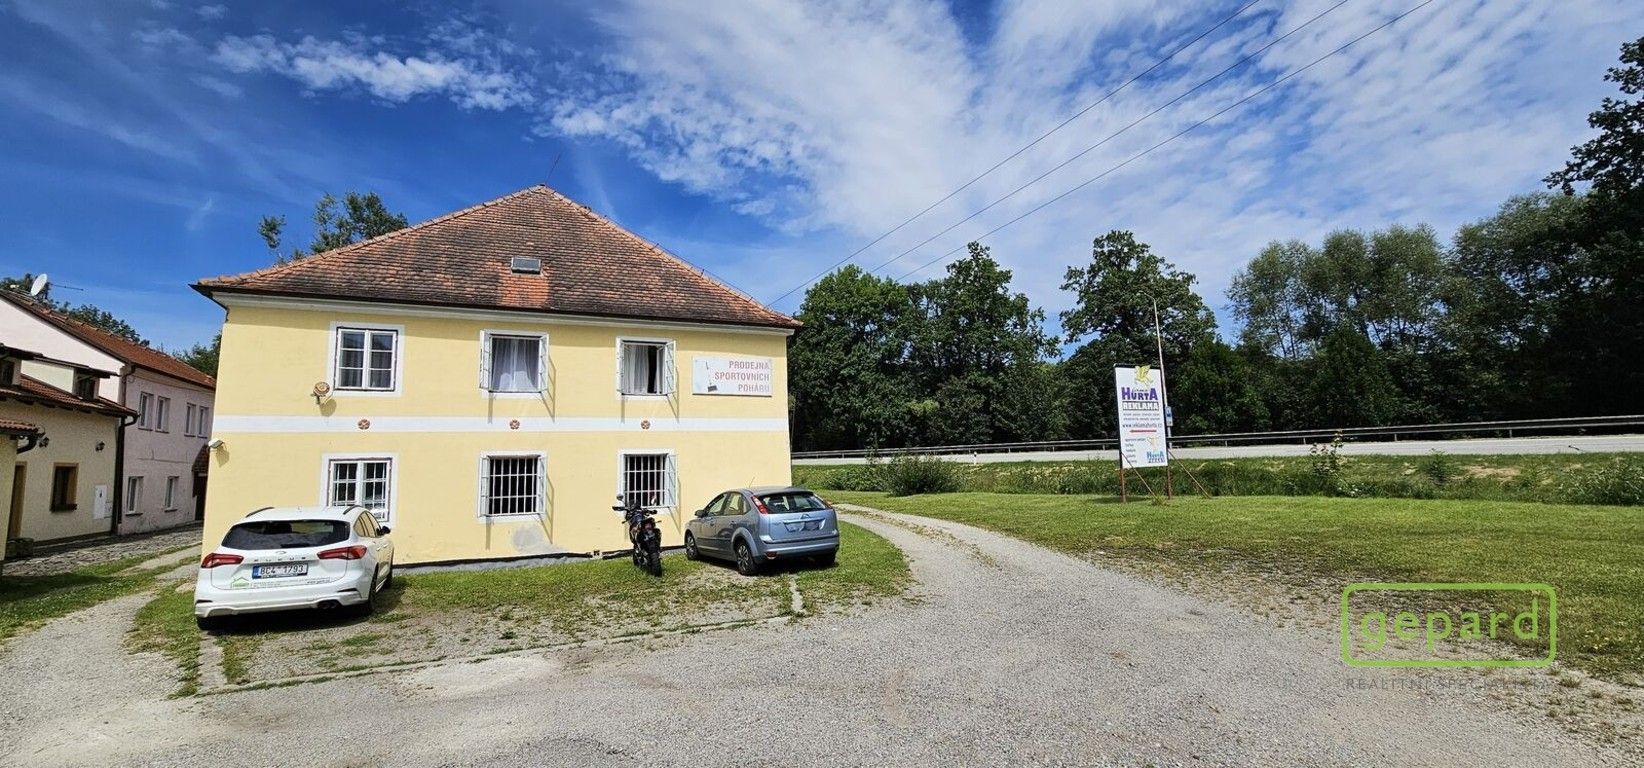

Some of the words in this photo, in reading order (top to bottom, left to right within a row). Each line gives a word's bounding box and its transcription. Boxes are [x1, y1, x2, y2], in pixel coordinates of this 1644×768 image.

[728, 360, 770, 370] PRODEJNA
[1121, 387, 1158, 401] HURTA
[1122, 401, 1160, 411] REKLAMA
